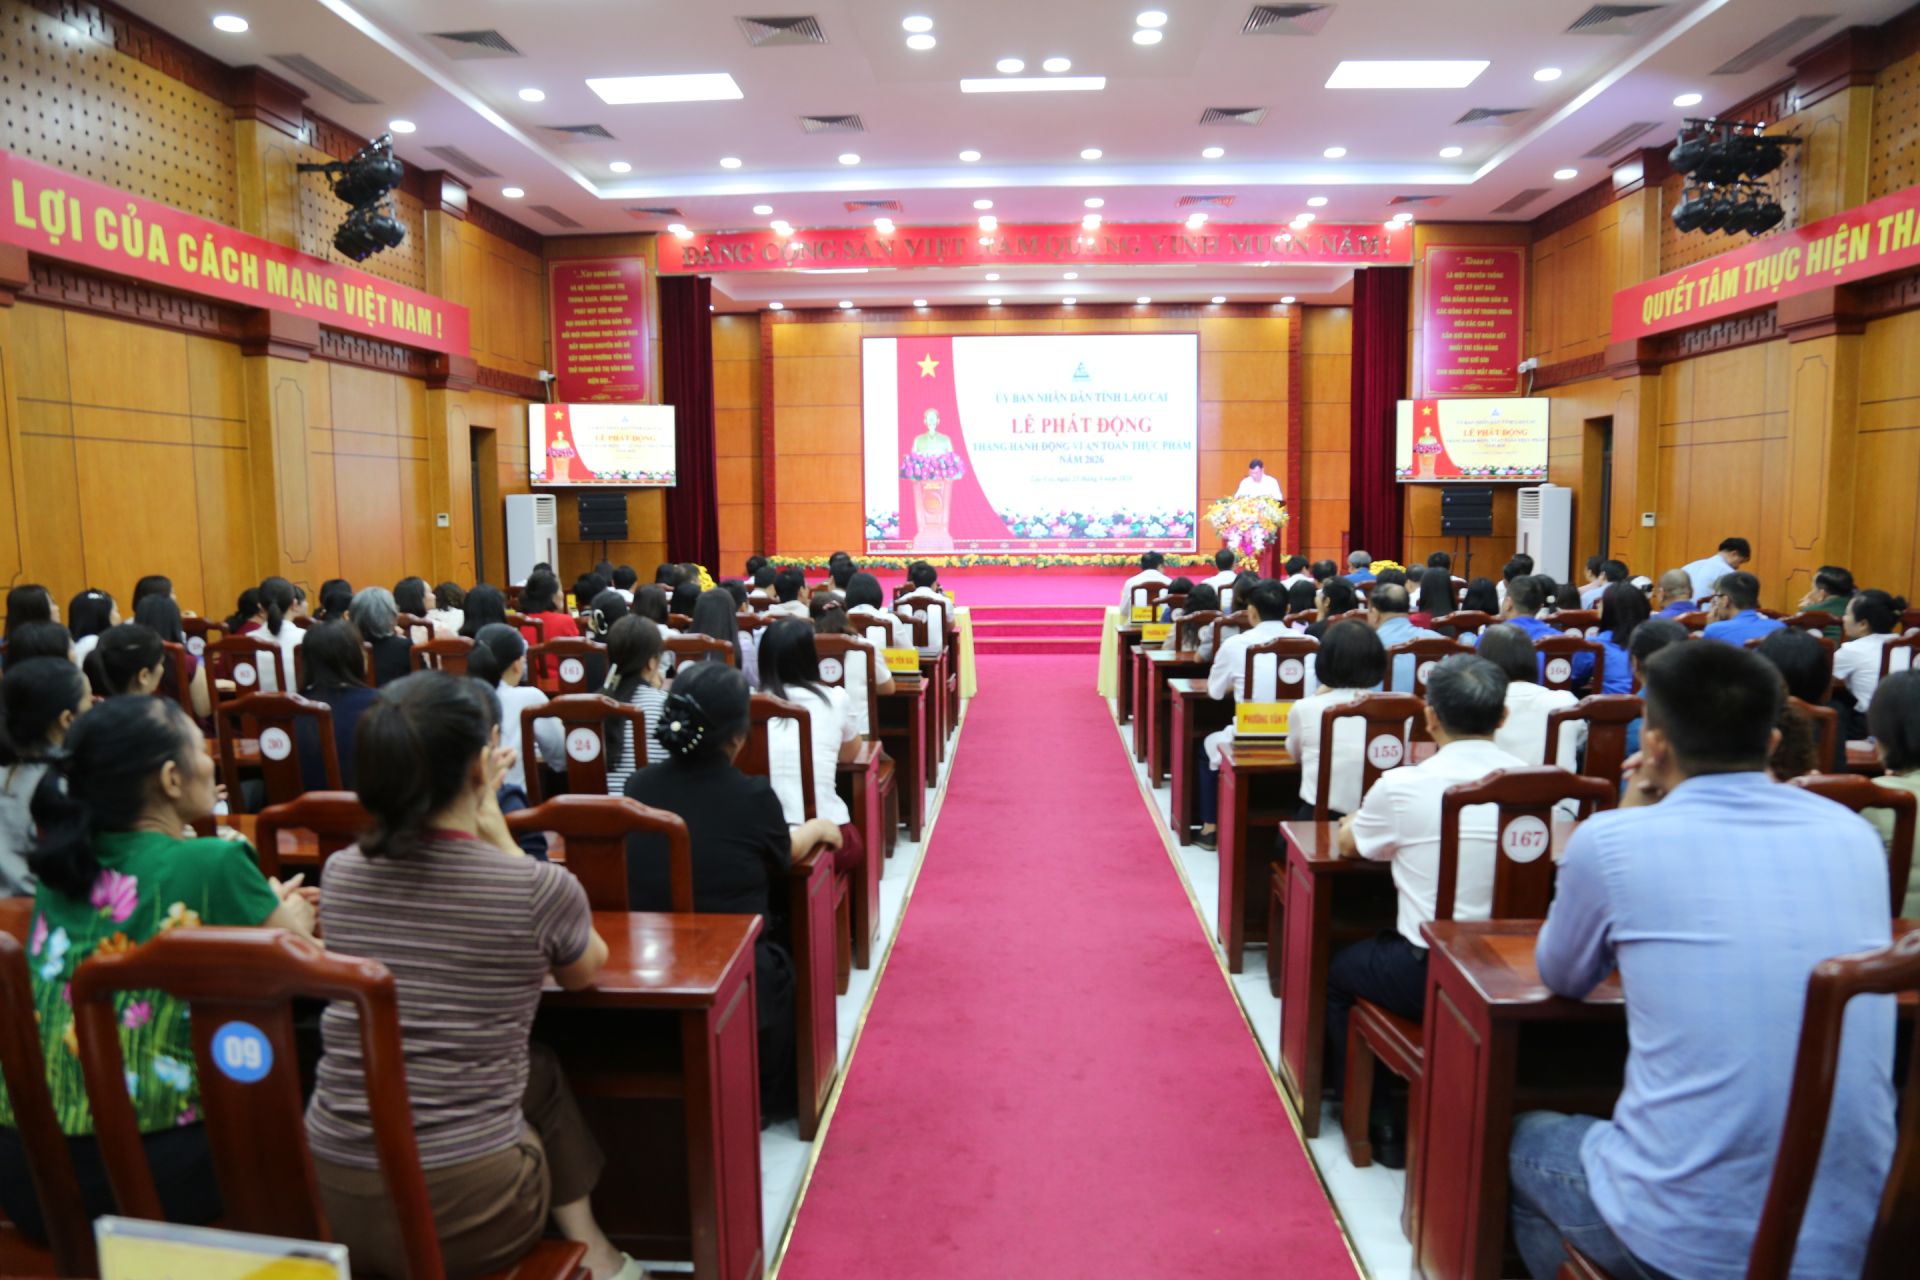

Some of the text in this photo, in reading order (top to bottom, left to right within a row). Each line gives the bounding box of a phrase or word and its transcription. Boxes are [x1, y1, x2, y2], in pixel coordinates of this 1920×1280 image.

[1151, 234, 1220, 256] VINH
[12, 179, 82, 246] LỢI
[94, 203, 170, 268] CỦA
[178, 233, 260, 289] CÁCH
[266, 258, 338, 309] MẠNG
[343, 282, 387, 327] VIỆT
[391, 297, 433, 337] NAM
[1642, 274, 1697, 326] QUYẾT
[1699, 266, 1740, 308] TÂM
[1745, 246, 1802, 293] THỰC
[1805, 223, 1871, 276] HIỆN
[1013, 392, 1034, 403] BAN
[1149, 392, 1168, 402] CAI
[1012, 412, 1152, 437] LỄ PHÁT ĐỘNG
[823, 665, 837, 675] 77
[575, 737, 591, 752] 24
[1373, 745, 1400, 759] 155
[1510, 831, 1545, 848] 167
[224, 1036, 262, 1070] 09
